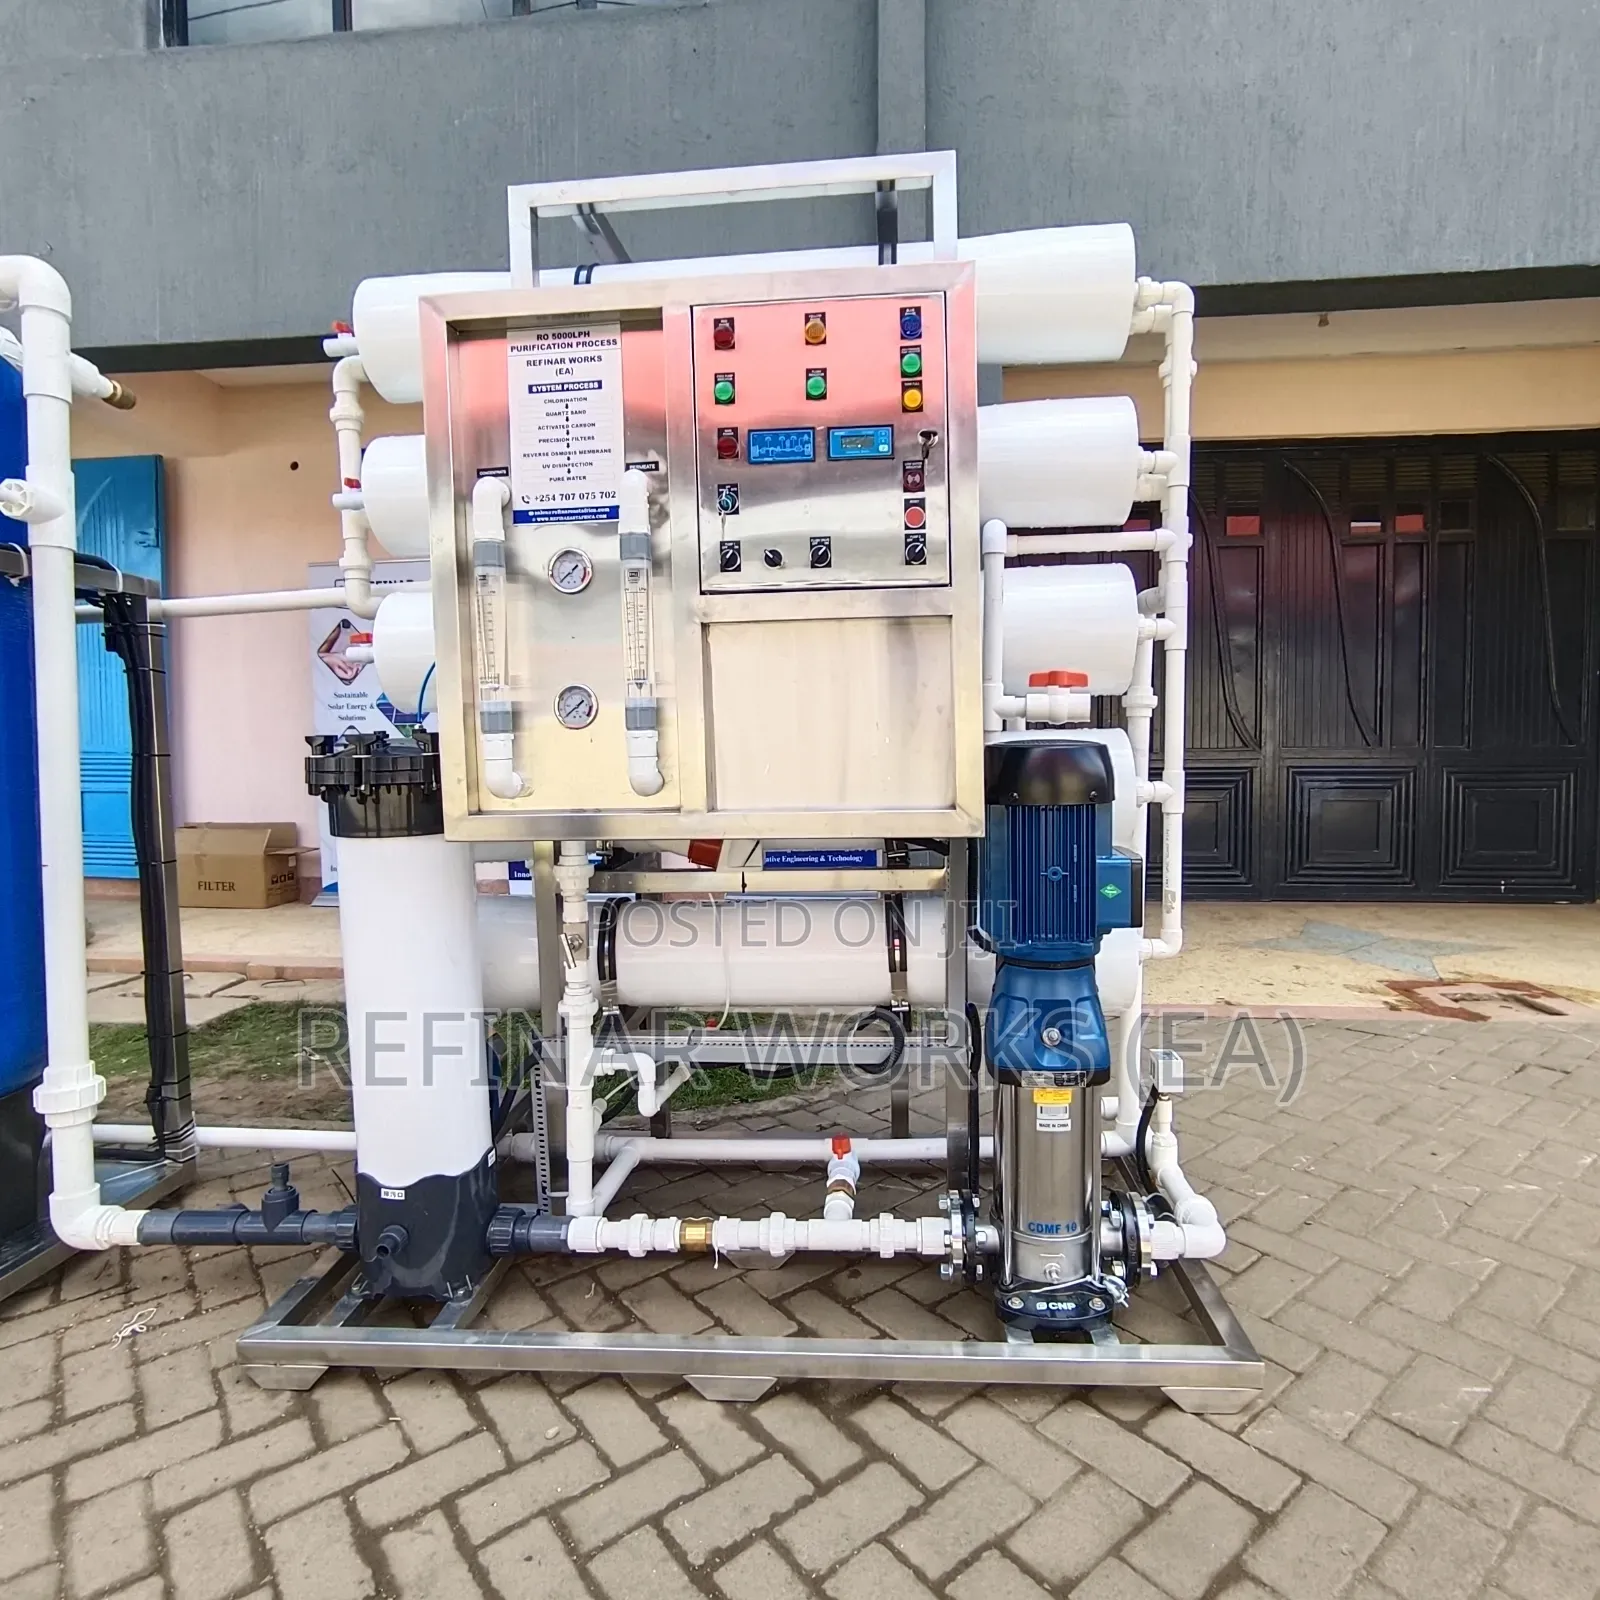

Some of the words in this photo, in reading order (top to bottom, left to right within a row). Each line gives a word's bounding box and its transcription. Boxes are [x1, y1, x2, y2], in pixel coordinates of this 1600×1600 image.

[536, 333, 549, 341] RO
[552, 330, 590, 339] 5000LPH
[510, 342, 573, 352] PURIFICATION
[576, 338, 618, 348] PROCESS
[526, 358, 566, 367] REFINAR
[568, 355, 603, 363] WORKS
[555, 367, 574, 377] (EA)
[532, 383, 562, 393] SYSTEM
[563, 381, 598, 390] PROCESS
[534, 494, 556, 502] +254
[579, 492, 596, 500] 075
[599, 491, 617, 499] 702
[827, 855, 863, 863] Technology
[198, 880, 236, 892] FILTER
[1028, 1222, 1061, 1234] CDMF
[1065, 1221, 1077, 1232] 10
[1048, 1302, 1076, 1310] CNP
